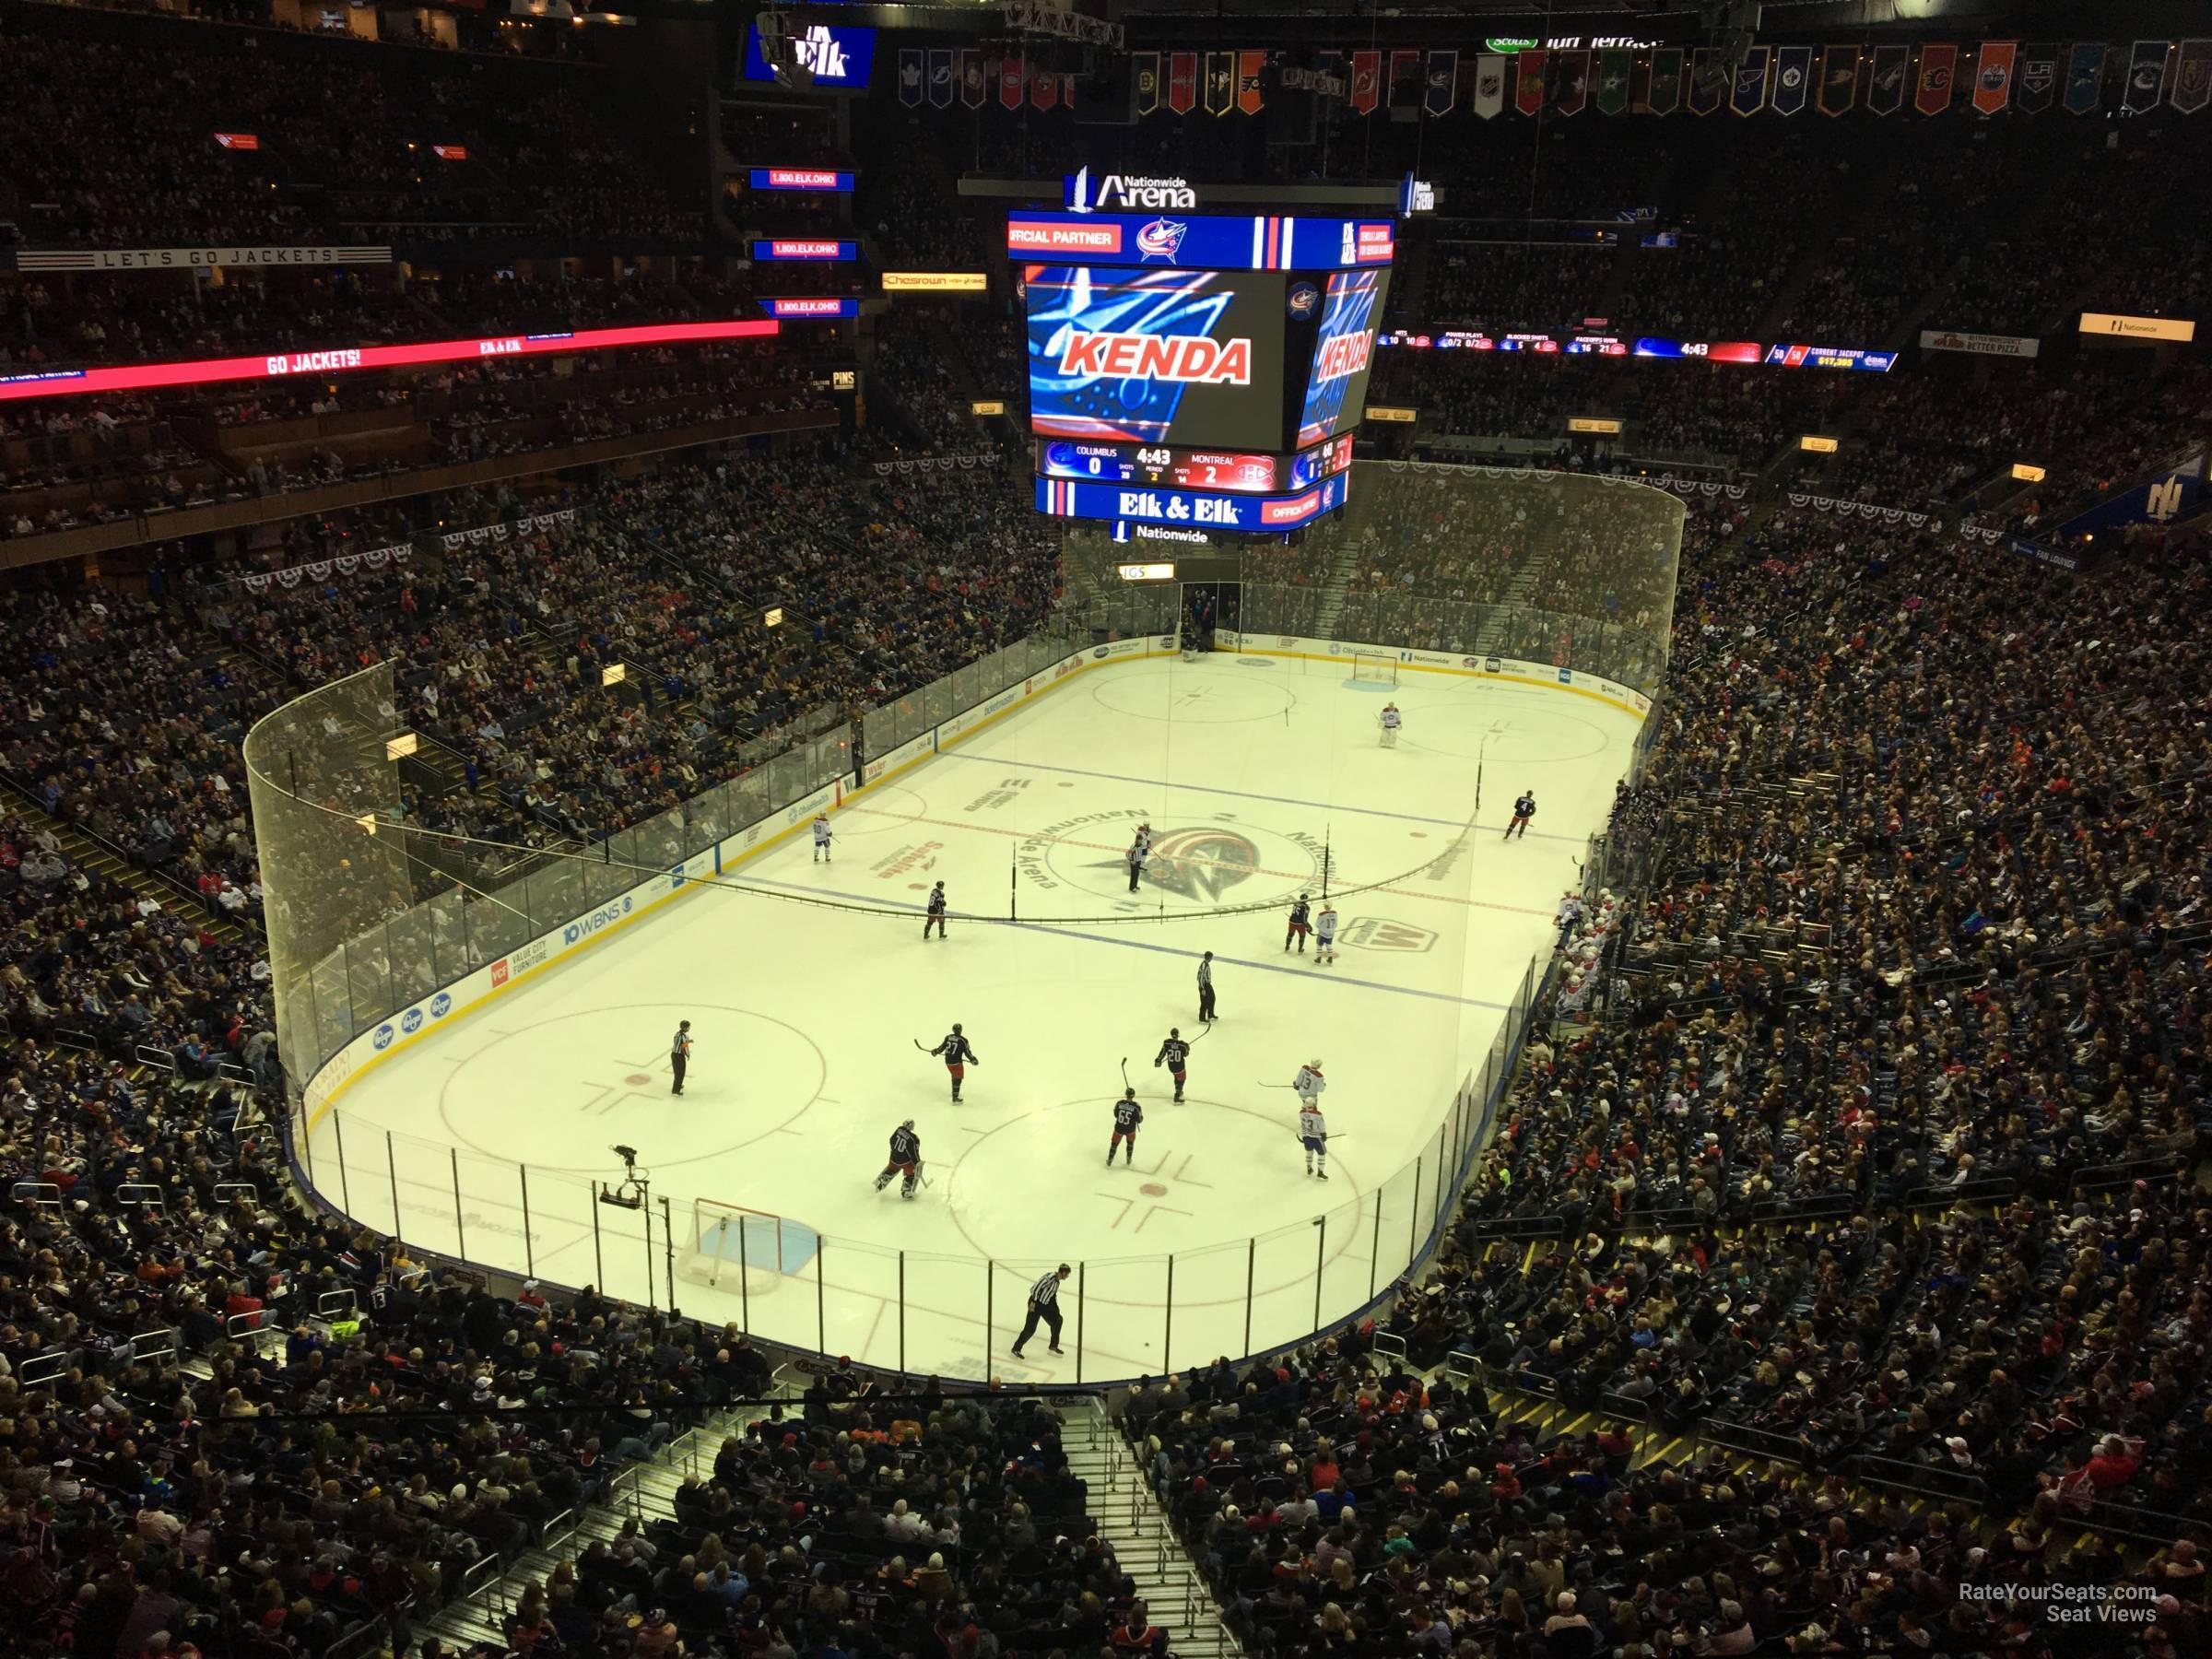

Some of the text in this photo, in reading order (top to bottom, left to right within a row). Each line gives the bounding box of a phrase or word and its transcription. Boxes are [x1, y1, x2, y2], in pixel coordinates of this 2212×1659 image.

[772, 173, 834, 184] 1.800.ELK.OHIO
[1124, 175, 1186, 188] Nationwide
[1096, 175, 1195, 207] Arena
[1053, 231, 1112, 245] PARTNER
[775, 244, 837, 254] 1.800.ELK.OHIO
[103, 249, 333, 266] LET'S GO JACKETS
[778, 301, 839, 312] 1.800.ELK.OHIO
[2124, 324, 2158, 333] Nationwide
[1447, 338, 1480, 347] 0/2 0/2
[1582, 344, 1591, 352] 16
[1681, 343, 1709, 355] 4:43
[1967, 342, 1994, 352] BETTER
[1058, 331, 1251, 384] KENDA
[1317, 328, 1373, 383] KENDA
[1774, 349, 1802, 361] 50 50
[1811, 347, 1865, 359] CURRENT JACKPOT
[267, 348, 360, 375] GO JACKETS!
[1077, 446, 1117, 457] COLUMBUS
[1136, 448, 1171, 465] 4:43
[1088, 457, 1101, 475] 0
[1192, 454, 1234, 465] MONTREAL
[1151, 473, 1159, 481] 2
[1205, 466, 1217, 484] 2
[1119, 492, 1240, 524] Elk & Elk
[1136, 525, 1208, 543] Nationwide
[2035, 549, 2050, 560] FAN
[2049, 554, 2077, 570] LOUNGE
[1124, 567, 1143, 577] IGS
[1414, 654, 1450, 665] Nationwide
[1018, 853, 1058, 890] Arena
[512, 940, 547, 964] VALUE CITY
[513, 950, 547, 975] FURNITURE
[946, 1041, 959, 1054] 27
[1168, 1049, 1182, 1063] 20
[1300, 1075, 1312, 1090] 13
[1118, 1110, 1134, 1125] 65
[893, 1135, 907, 1153] 70
[478, 1218, 541, 1242] VECTOR
[372, 1292, 386, 1310] 13
